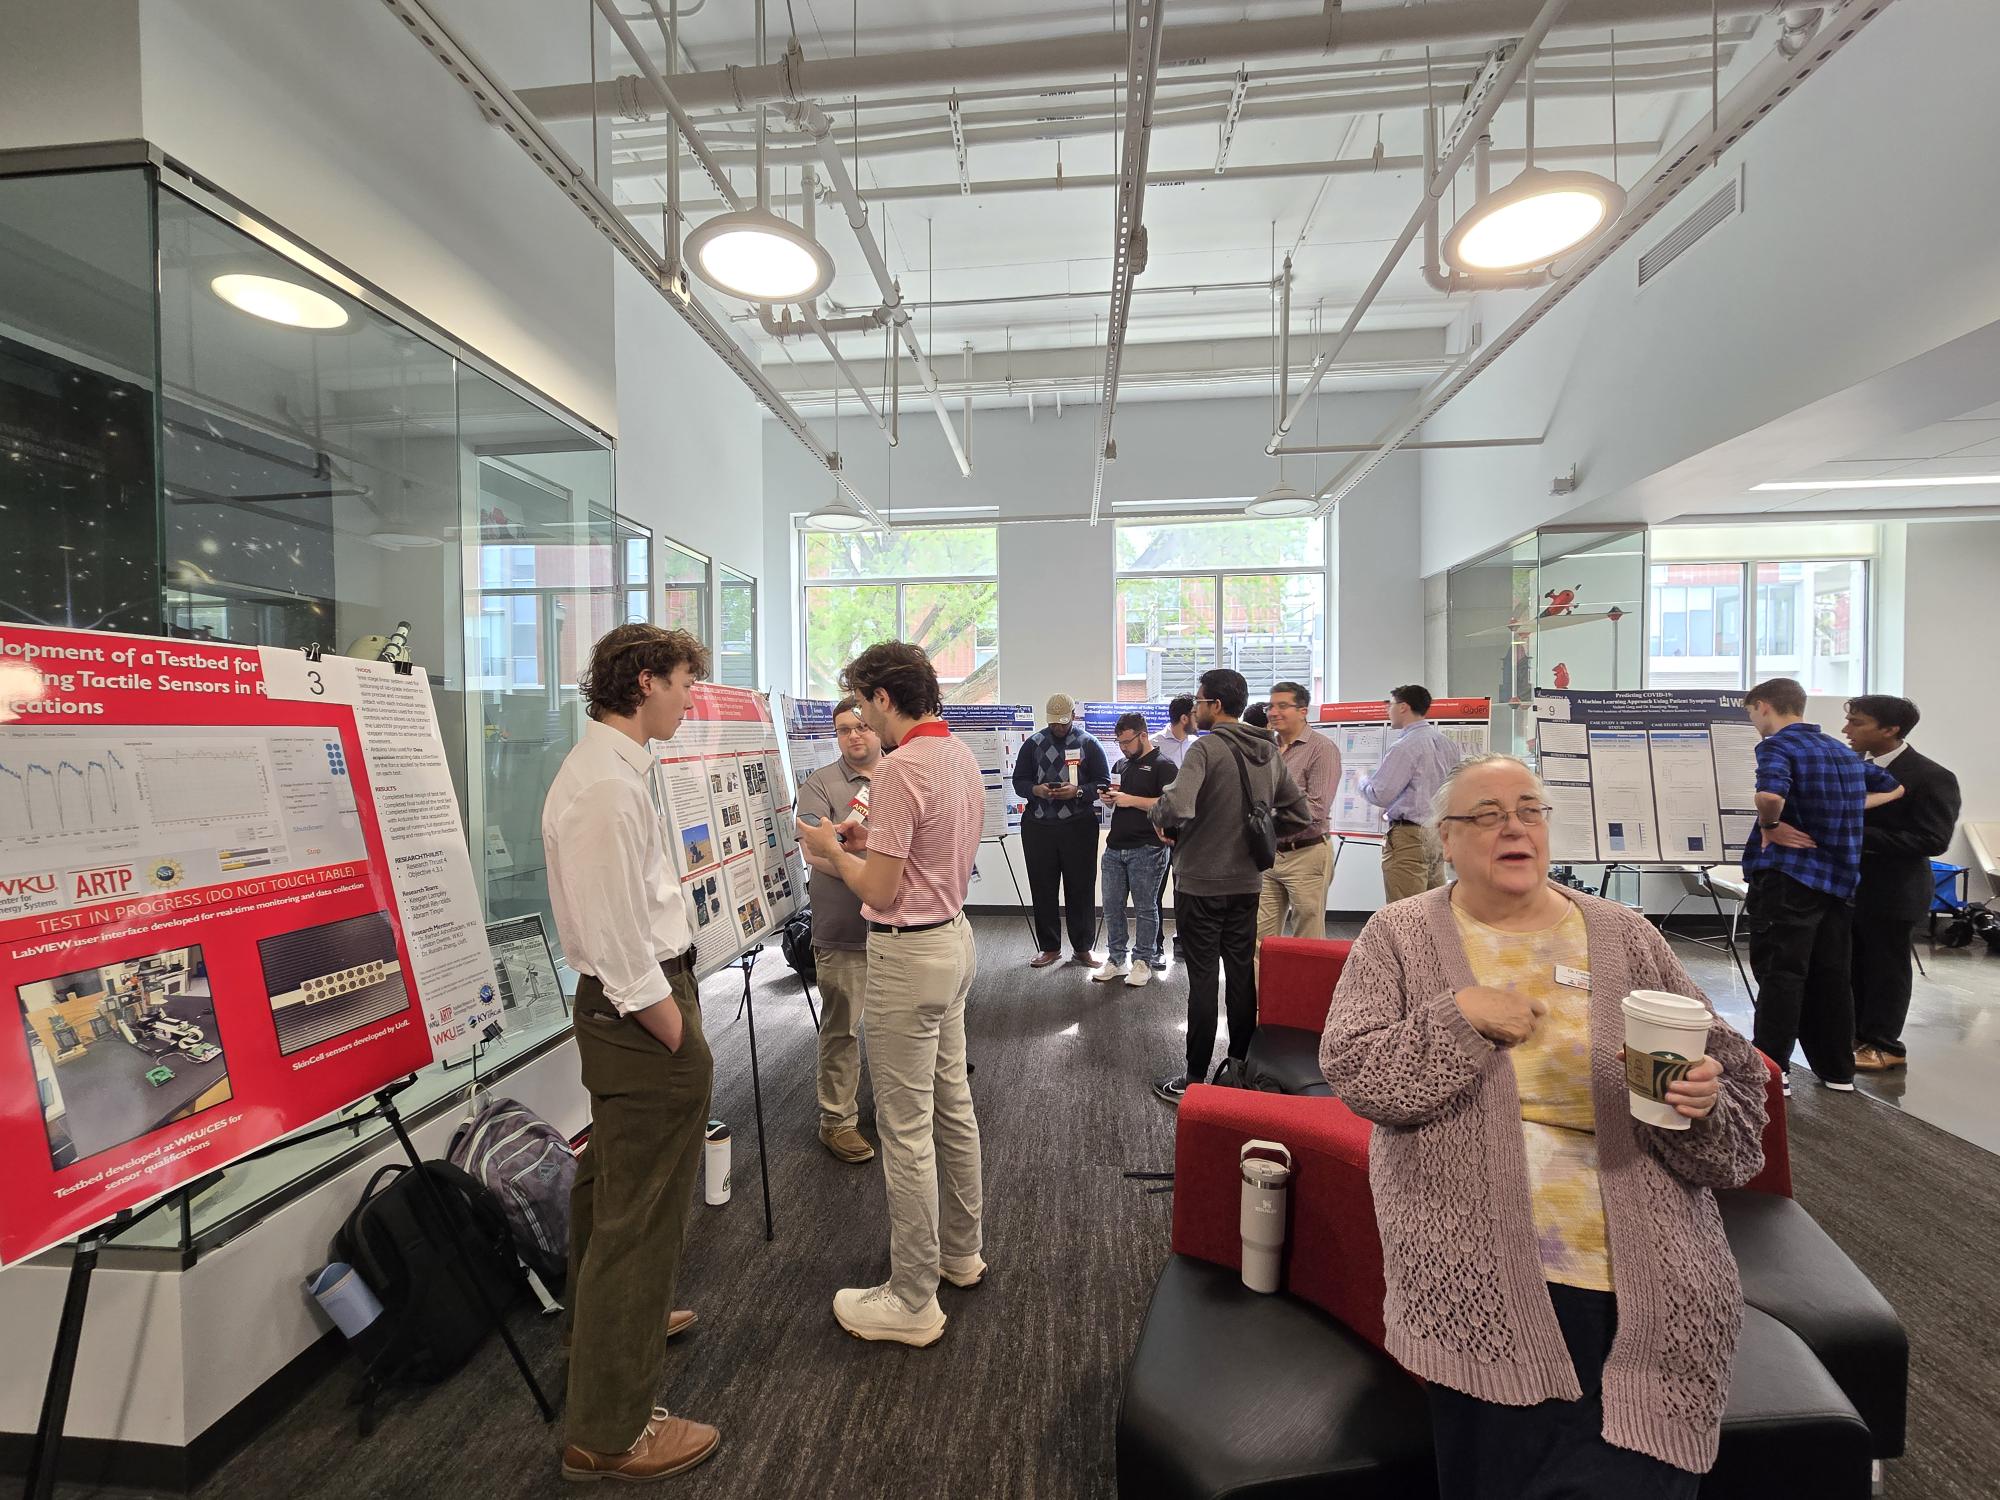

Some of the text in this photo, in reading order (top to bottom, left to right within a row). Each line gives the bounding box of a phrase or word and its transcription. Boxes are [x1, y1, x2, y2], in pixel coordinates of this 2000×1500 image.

[111, 648, 137, 668] of
[141, 653, 154, 665] a
[156, 650, 229, 670] Testbed
[233, 657, 258, 675] for
[76, 670, 152, 690] Tactile
[158, 675, 231, 694] Sensors
[235, 680, 251, 694] in
[309, 671, 325, 695] 3
[1462, 705, 1488, 714] Ogden
[1548, 705, 1556, 716] 9
[384, 800, 406, 808] Completed
[386, 808, 408, 816] Completed
[406, 860, 428, 870] Research
[157, 869, 174, 878] NSF
[408, 869, 432, 878] Objective
[76, 868, 133, 898] ARTP
[20, 894, 32, 902] for
[402, 887, 424, 897] Research
[24, 900, 58, 910] Systems
[37, 866, 356, 934] TEST IN PROGRESS (DO NOT TOUCH TABLE)
[12, 882, 364, 960] LabVIEW user interface developed for real-time monitoring and data collection
[432, 1026, 458, 1046] WKU
[292, 1053, 325, 1070] SkinCell
[325, 1042, 353, 1059] sensors
[353, 1028, 387, 1047] developed
[387, 1026, 395, 1034] by
[53, 1114, 244, 1199] Testbed developed at WKU/CES for
[105, 1139, 211, 1192] sensor qualifications
